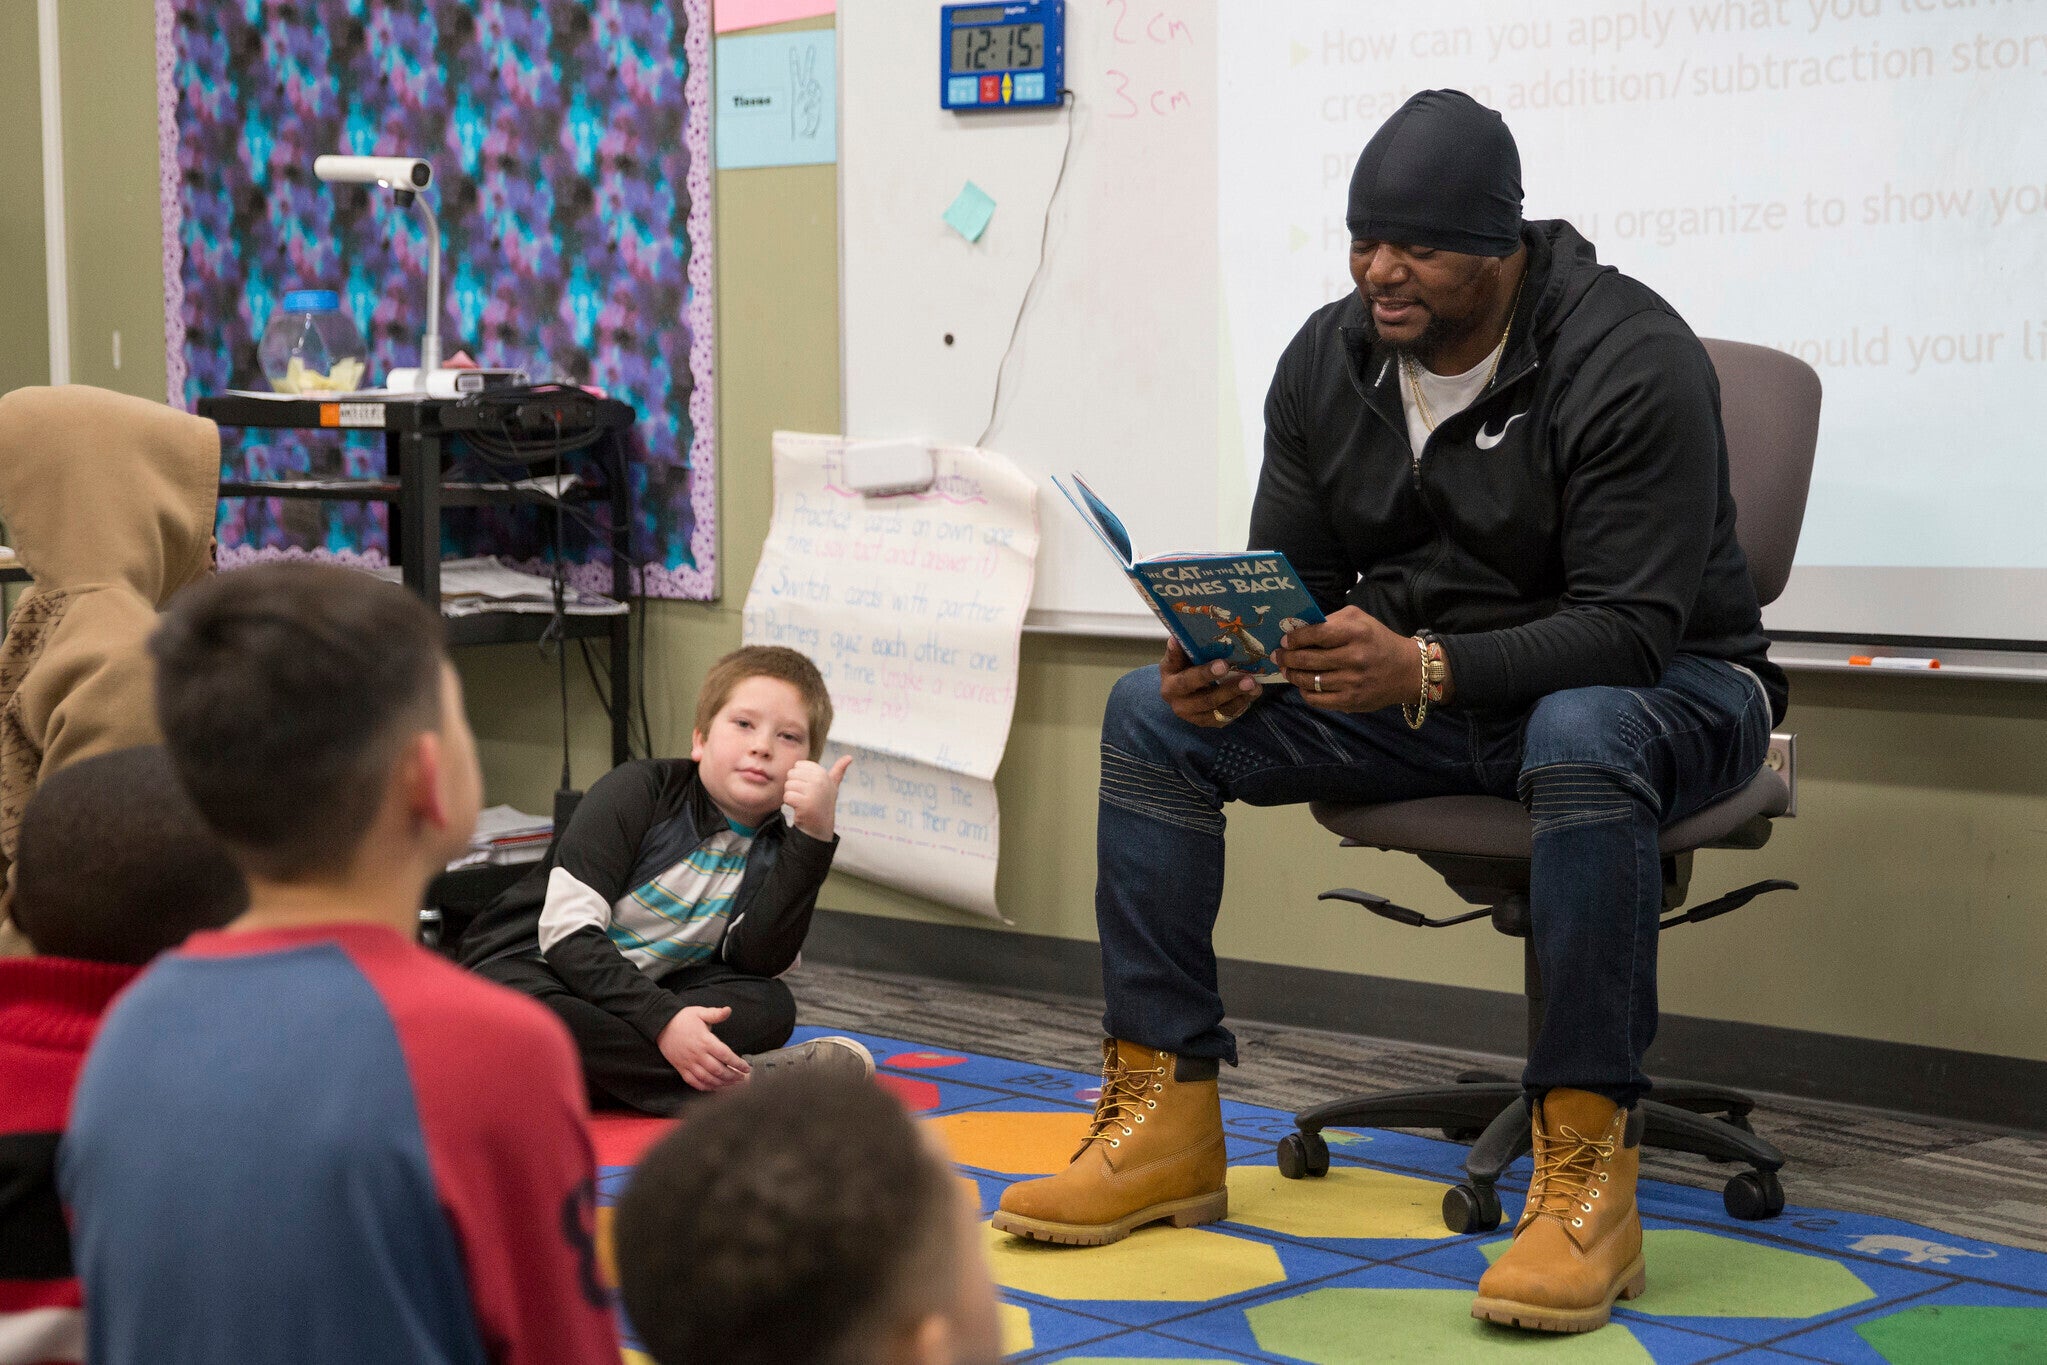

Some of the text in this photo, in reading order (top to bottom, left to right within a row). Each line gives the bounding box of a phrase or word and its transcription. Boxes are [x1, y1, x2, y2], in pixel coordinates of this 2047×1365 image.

[1105, 0, 1194, 46] 2 cm
[1321, 0, 1882, 65] How can you apply what you
[966, 25, 1033, 69] 12:15
[1106, 69, 1192, 118] 3 cm
[1507, 40, 1935, 112] addition/subtraction
[1614, 194, 1788, 248] organize
[1803, 191, 1847, 229] to
[1862, 180, 1973, 226] show
[1988, 184, 2047, 227] yo
[1904, 330, 2005, 376] your
[1152, 580, 1227, 597] COMES
[1228, 576, 1295, 594] BACK
[1162, 566, 1202, 581] CAT
[1232, 559, 1279, 576] HAT
